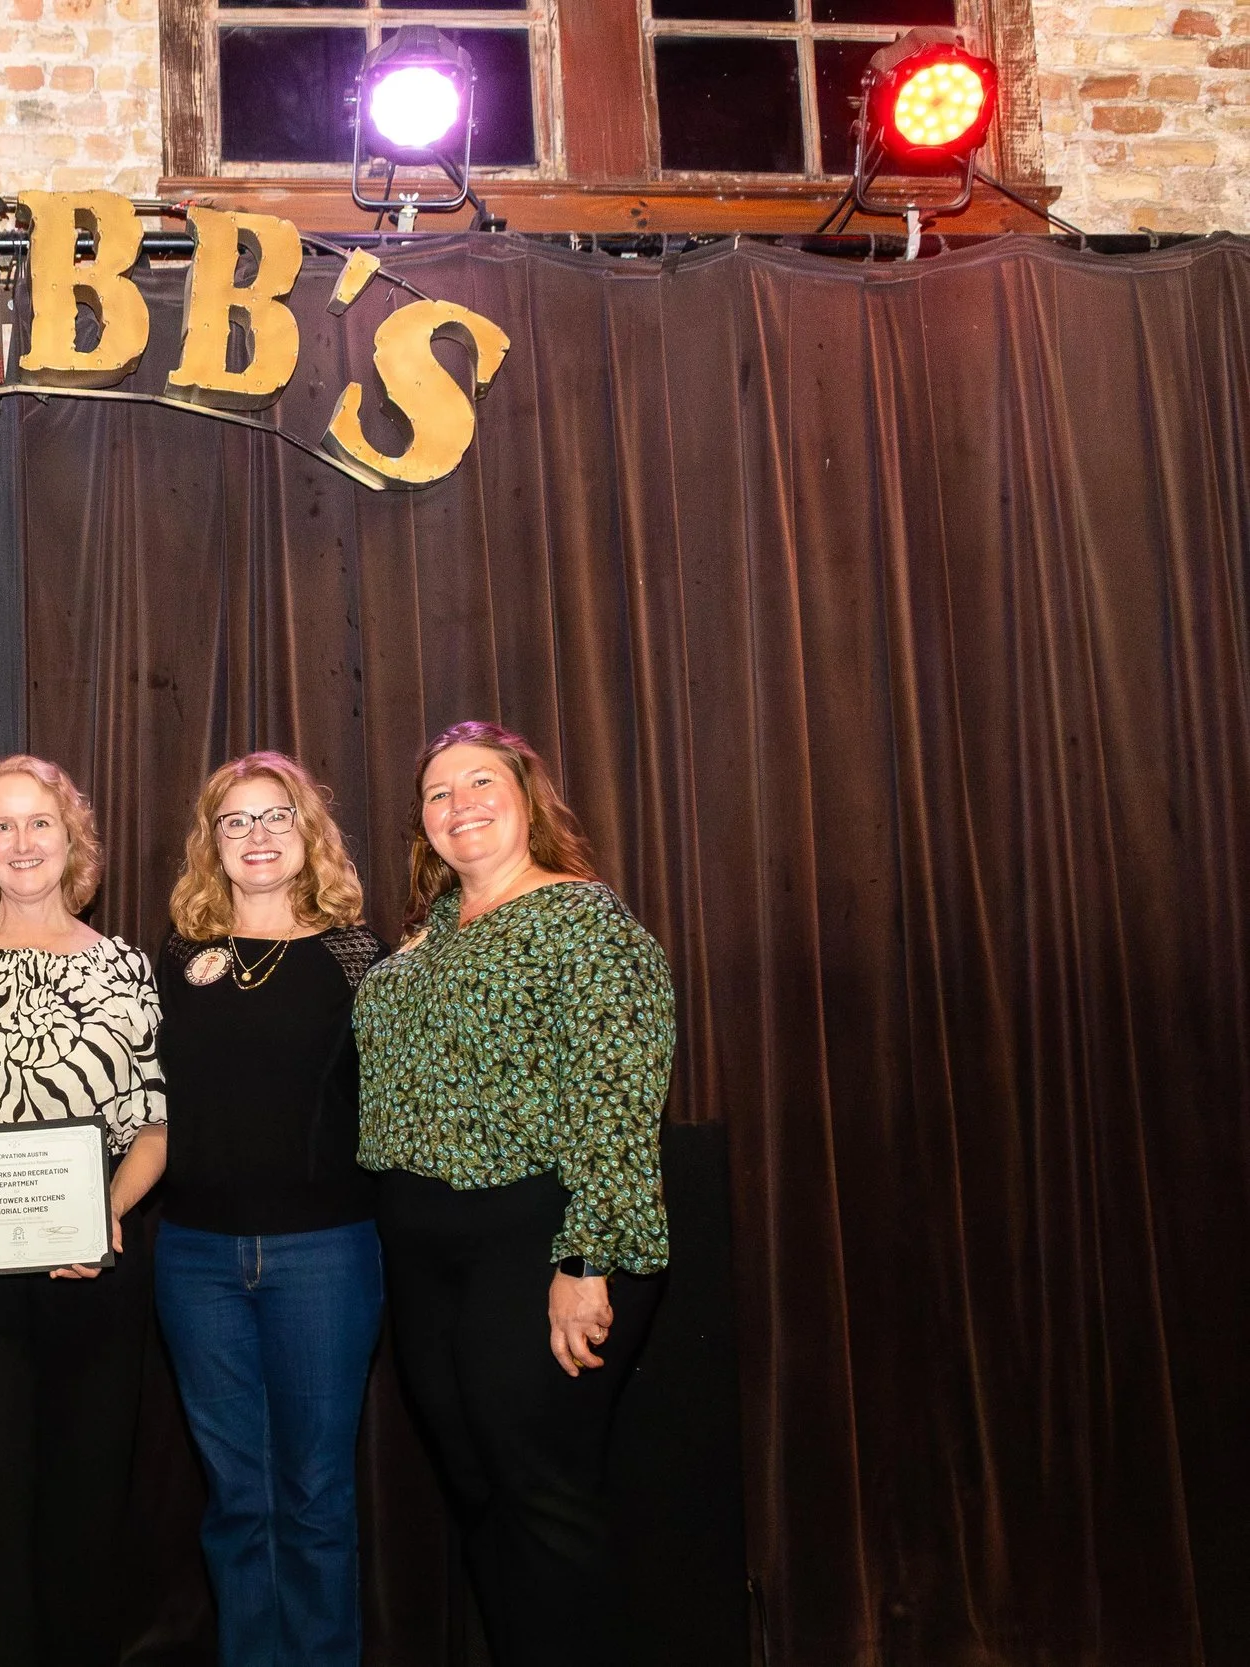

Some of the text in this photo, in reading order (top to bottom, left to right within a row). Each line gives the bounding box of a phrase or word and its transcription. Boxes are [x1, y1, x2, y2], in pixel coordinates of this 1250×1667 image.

[27, 1168, 69, 1176] RECREATION
[0, 1196, 23, 1205] TOWER
[31, 1194, 66, 1203] KITCHENS
